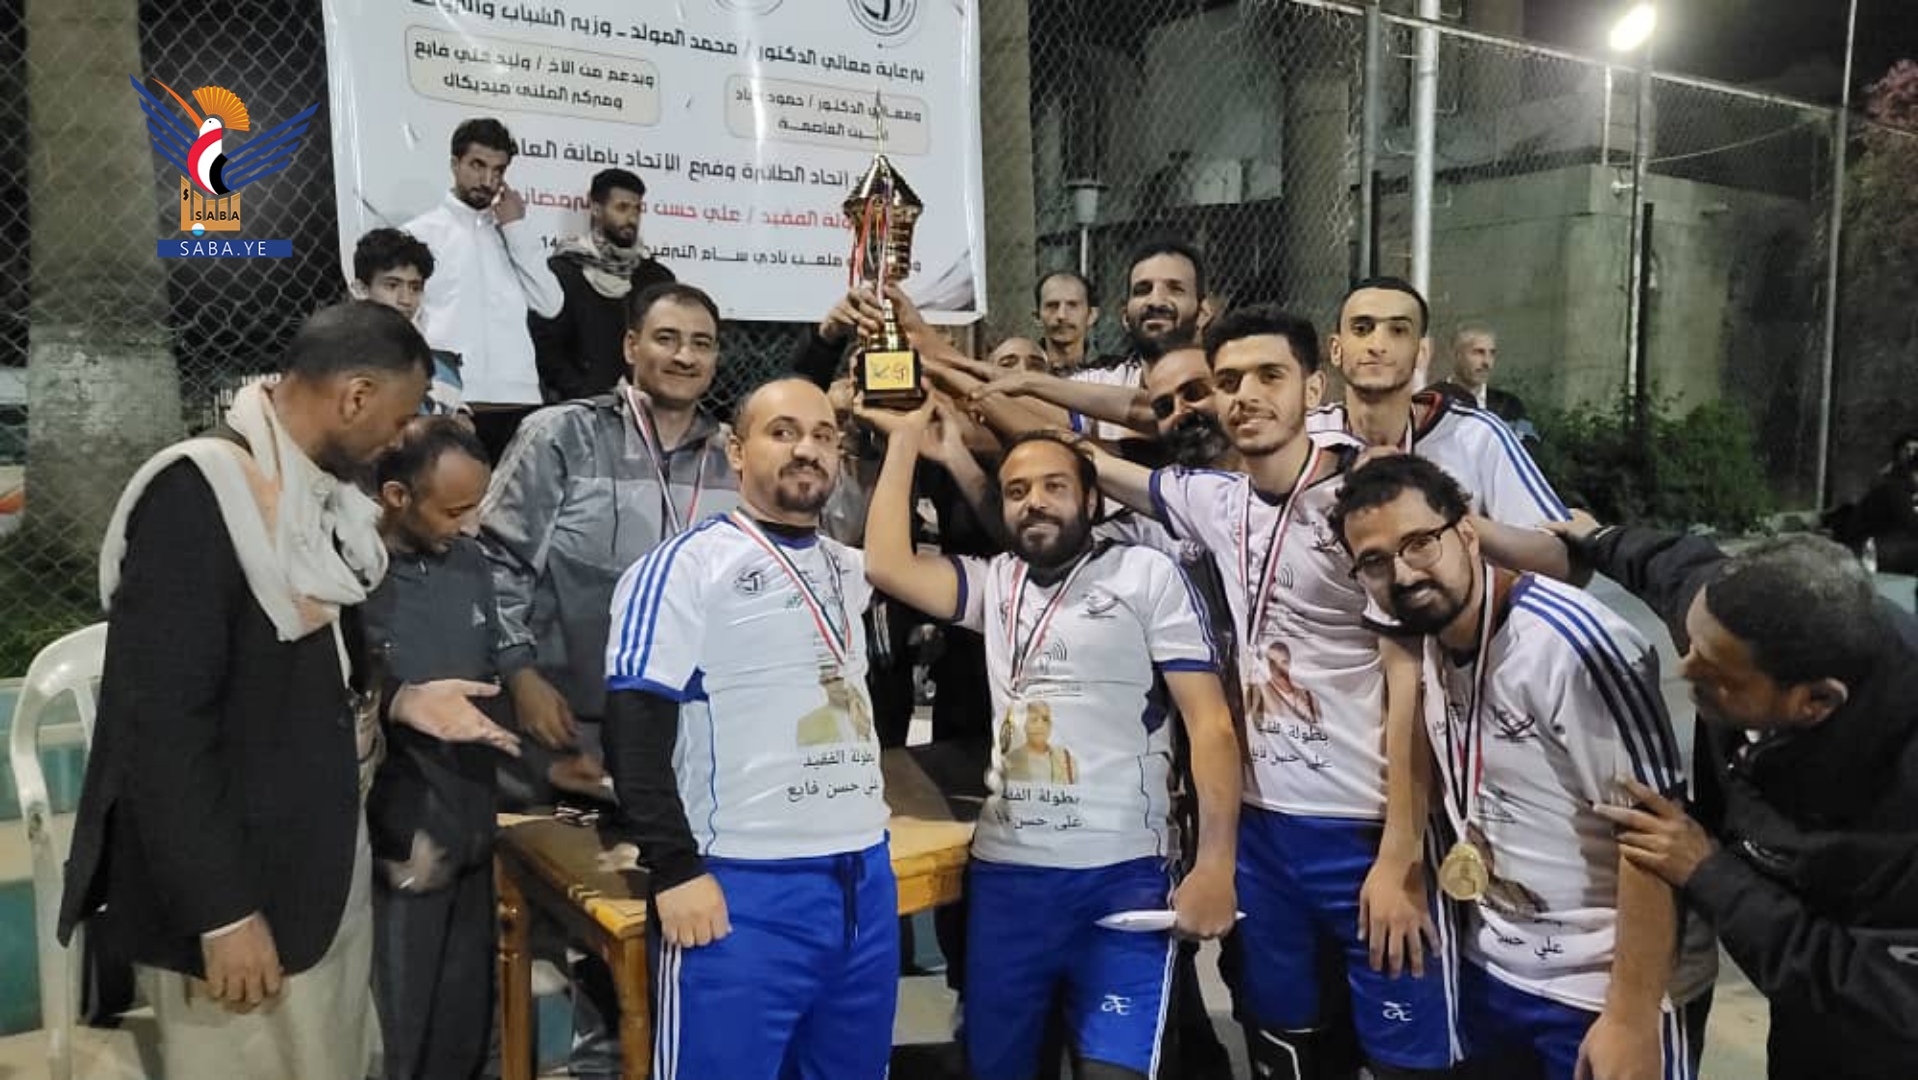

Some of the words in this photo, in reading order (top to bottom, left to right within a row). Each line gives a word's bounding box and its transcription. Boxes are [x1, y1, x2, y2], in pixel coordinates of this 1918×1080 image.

[502, 4, 564, 27] الشباب
[571, 15, 611, 37] وزير
[690, 36, 737, 54] محمد
[759, 46, 816, 66] الدكتور
[822, 54, 871, 74] معالي
[580, 65, 602, 79] من
[876, 61, 924, 83] برعاية
[818, 98, 864, 115] الدكتور
[521, 138, 557, 158] العا
[688, 159, 735, 182] وفرع
[703, 204, 740, 224] علي
[787, 780, 820, 803] فايع
[827, 782, 860, 799] حسن
[1498, 935, 1526, 946] حس
[1534, 936, 1564, 960] علي
